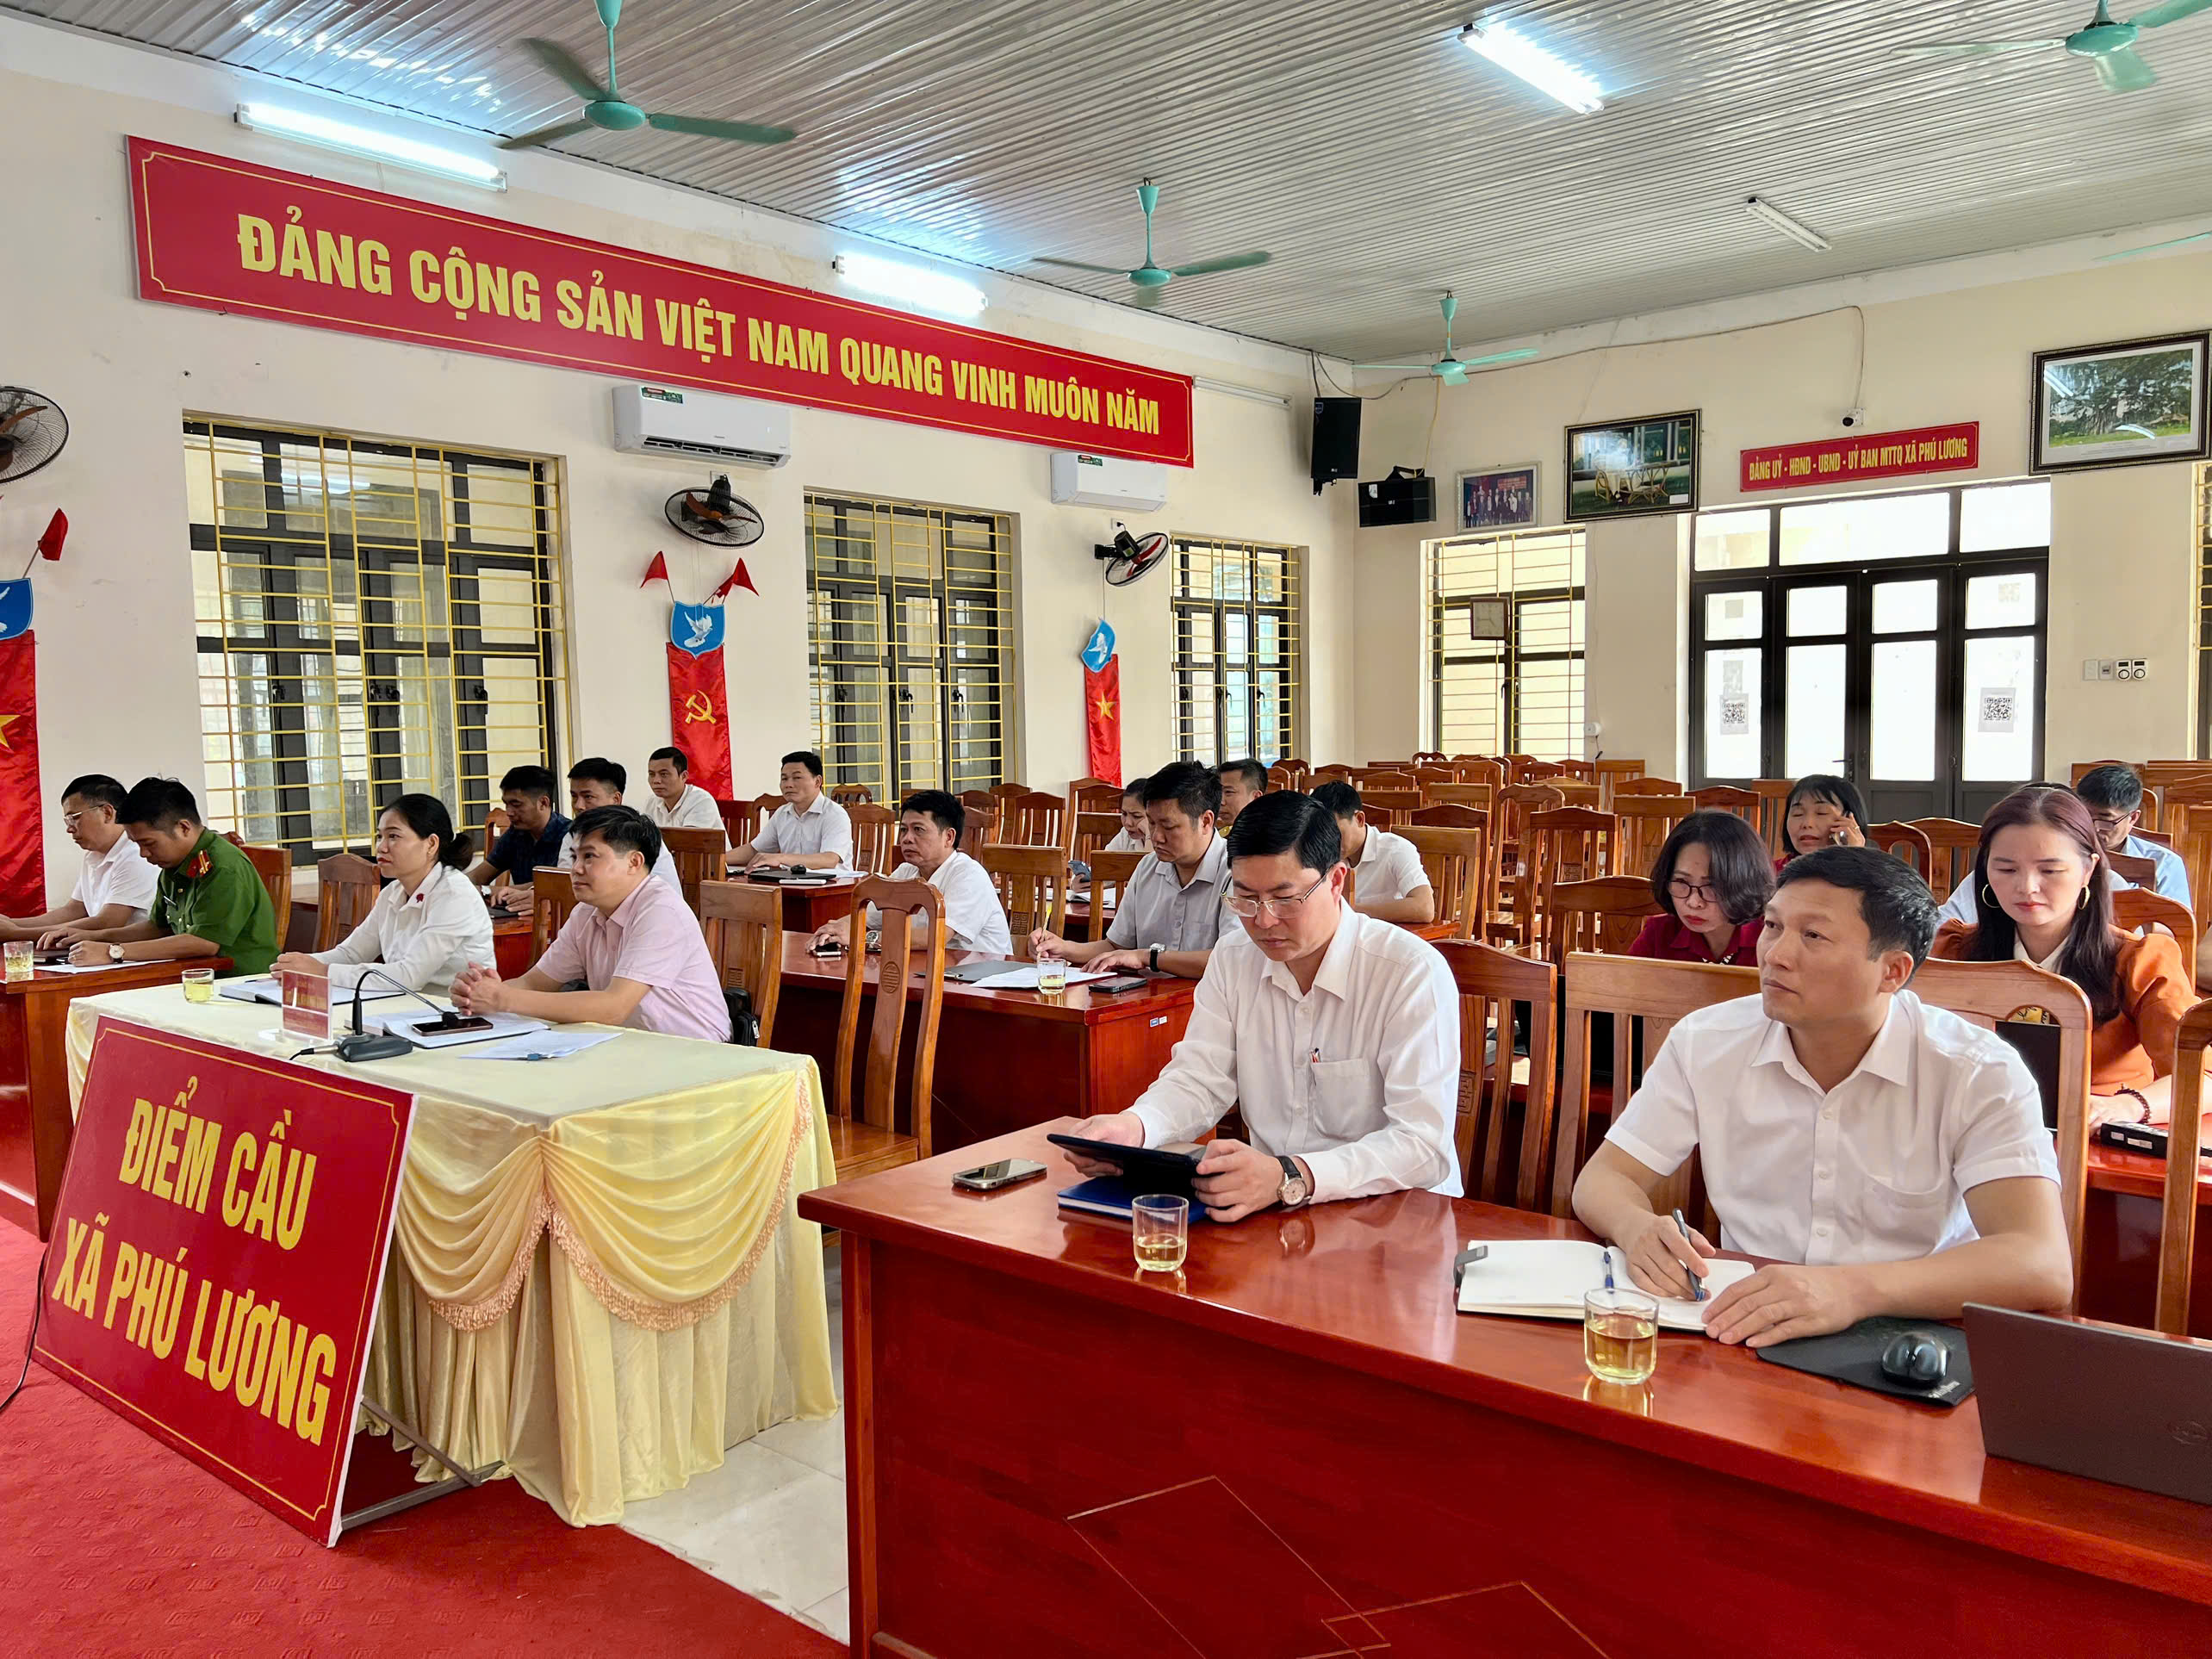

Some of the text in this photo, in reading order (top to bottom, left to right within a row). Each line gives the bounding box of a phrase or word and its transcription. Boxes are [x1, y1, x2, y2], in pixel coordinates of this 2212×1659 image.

[237, 206, 1159, 435] ĐẢNG CỘNG SẢN VIỆT NAM QUANG VINH MUÔN NĂM
[1749, 456, 1770, 481] ĐẢNG
[1789, 456, 1811, 476] HĐND
[1818, 452, 1841, 474] UBND
[1861, 448, 1879, 469] BAN
[1880, 445, 1903, 466] MTTQ
[1905, 439, 1917, 463] XÃ
[1918, 437, 1936, 463] PHÚ
[1938, 437, 1967, 460] LƯƠNG
[119, 1076, 316, 1250] ĐIỂM CẦU
[52, 1214, 337, 1445] XÃ PHÚ LƯƠNG
